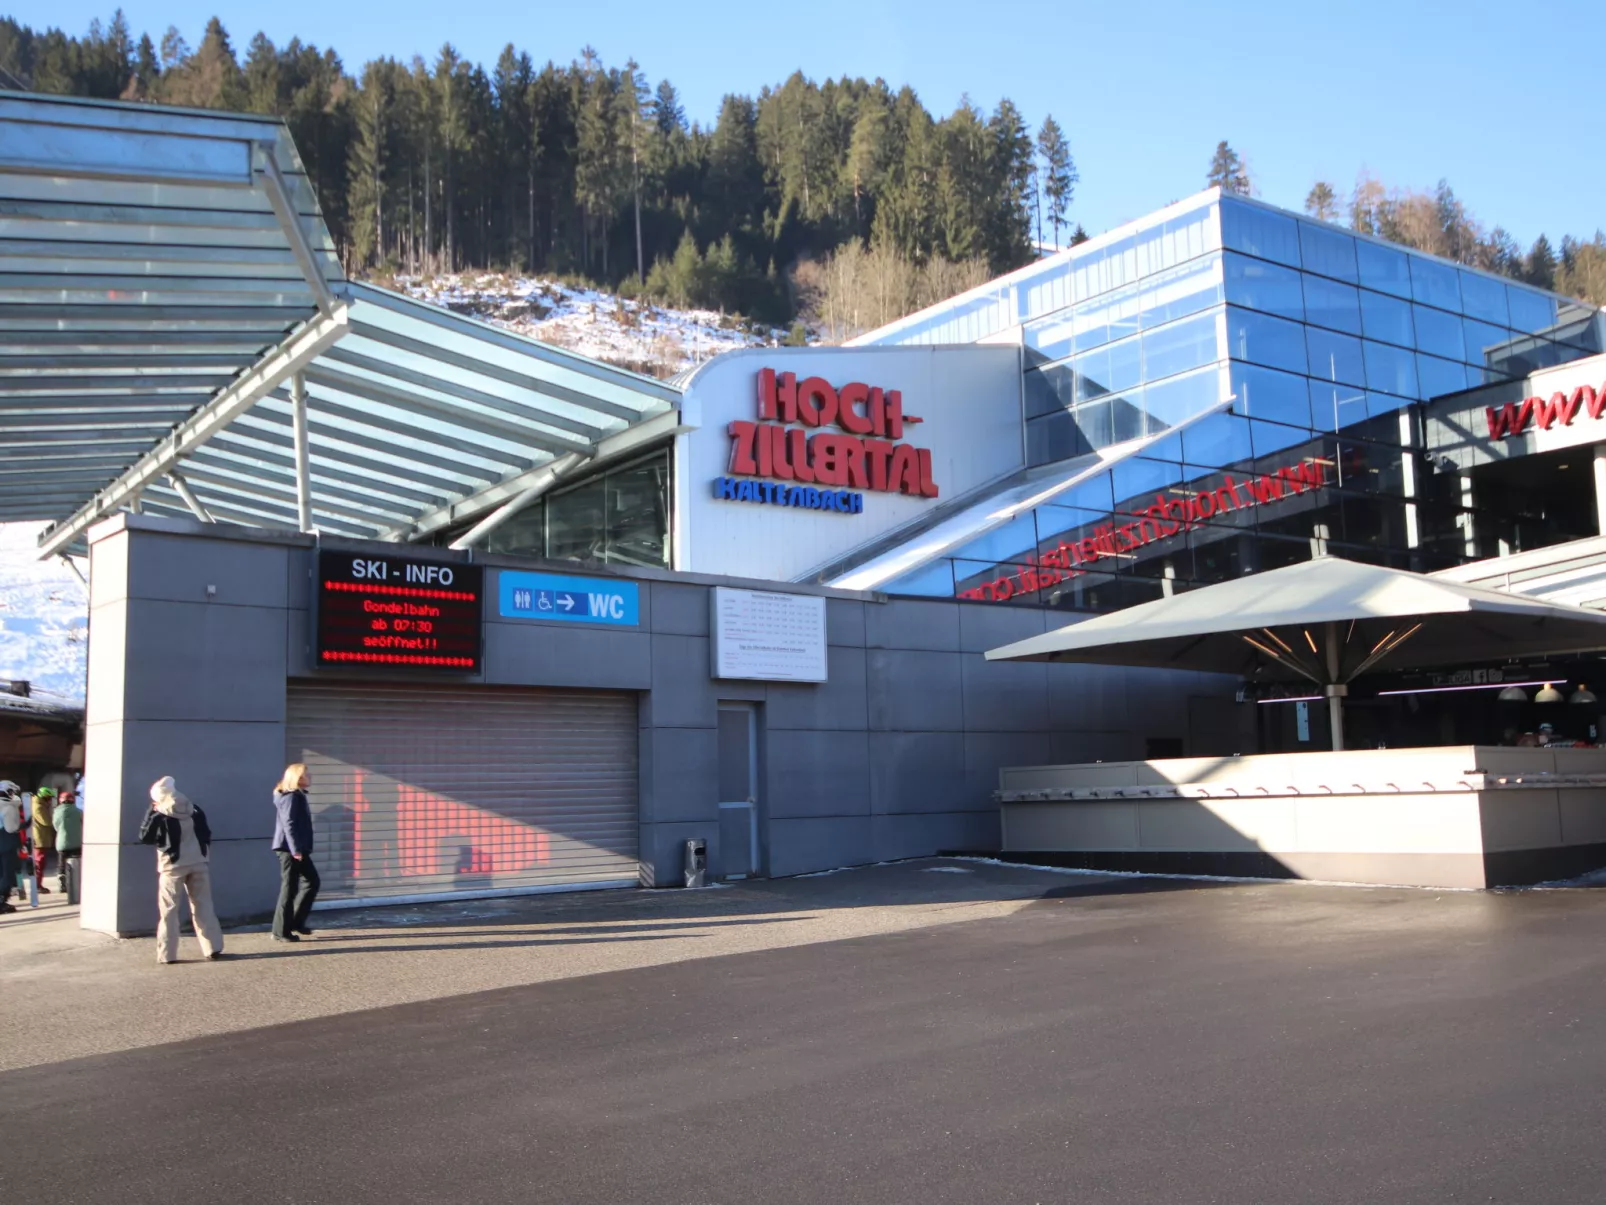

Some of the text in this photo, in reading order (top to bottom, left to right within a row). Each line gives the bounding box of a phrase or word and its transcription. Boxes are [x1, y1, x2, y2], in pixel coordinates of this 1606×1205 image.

[757, 367, 924, 440] HOCH-
[728, 420, 939, 498] ZILLERTAL
[713, 476, 864, 514] KALTENBACH
[352, 559, 387, 579] SKI
[406, 564, 453, 585] INFO
[364, 599, 440, 617] Gondelbahn
[588, 592, 624, 619] WC
[371, 618, 433, 634] ab 07:30
